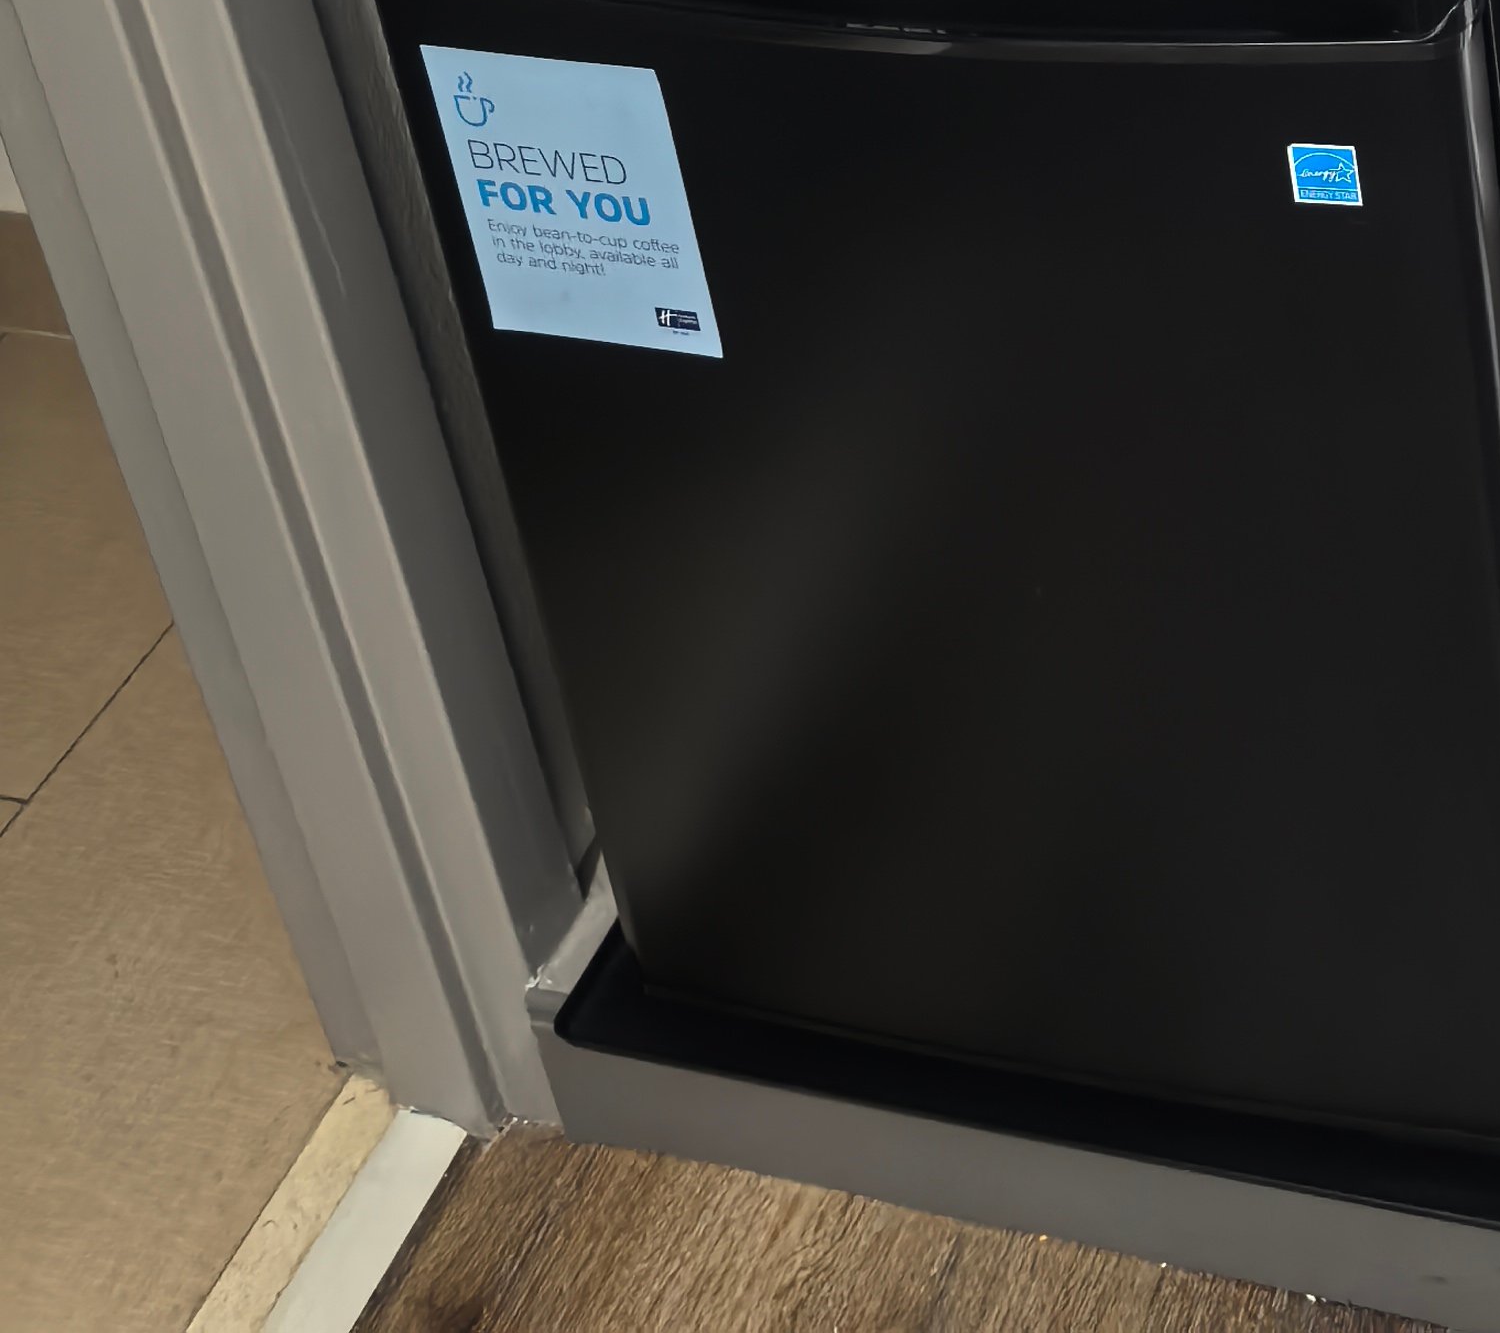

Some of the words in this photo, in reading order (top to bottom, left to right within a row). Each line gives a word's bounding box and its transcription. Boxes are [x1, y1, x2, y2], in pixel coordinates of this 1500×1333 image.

[467, 138, 628, 185] BREWED
[476, 178, 557, 216] FOR
[565, 188, 651, 226] YOU
[487, 218, 528, 237] Enjoy
[532, 224, 628, 249] bean-to-cup
[632, 238, 680, 255] coffee
[492, 235, 506, 248] in
[511, 236, 535, 252] the
[589, 249, 657, 267] available
[661, 256, 680, 270] all
[496, 252, 523, 267] day
[528, 256, 557, 271] and
[562, 259, 607, 277] night!
